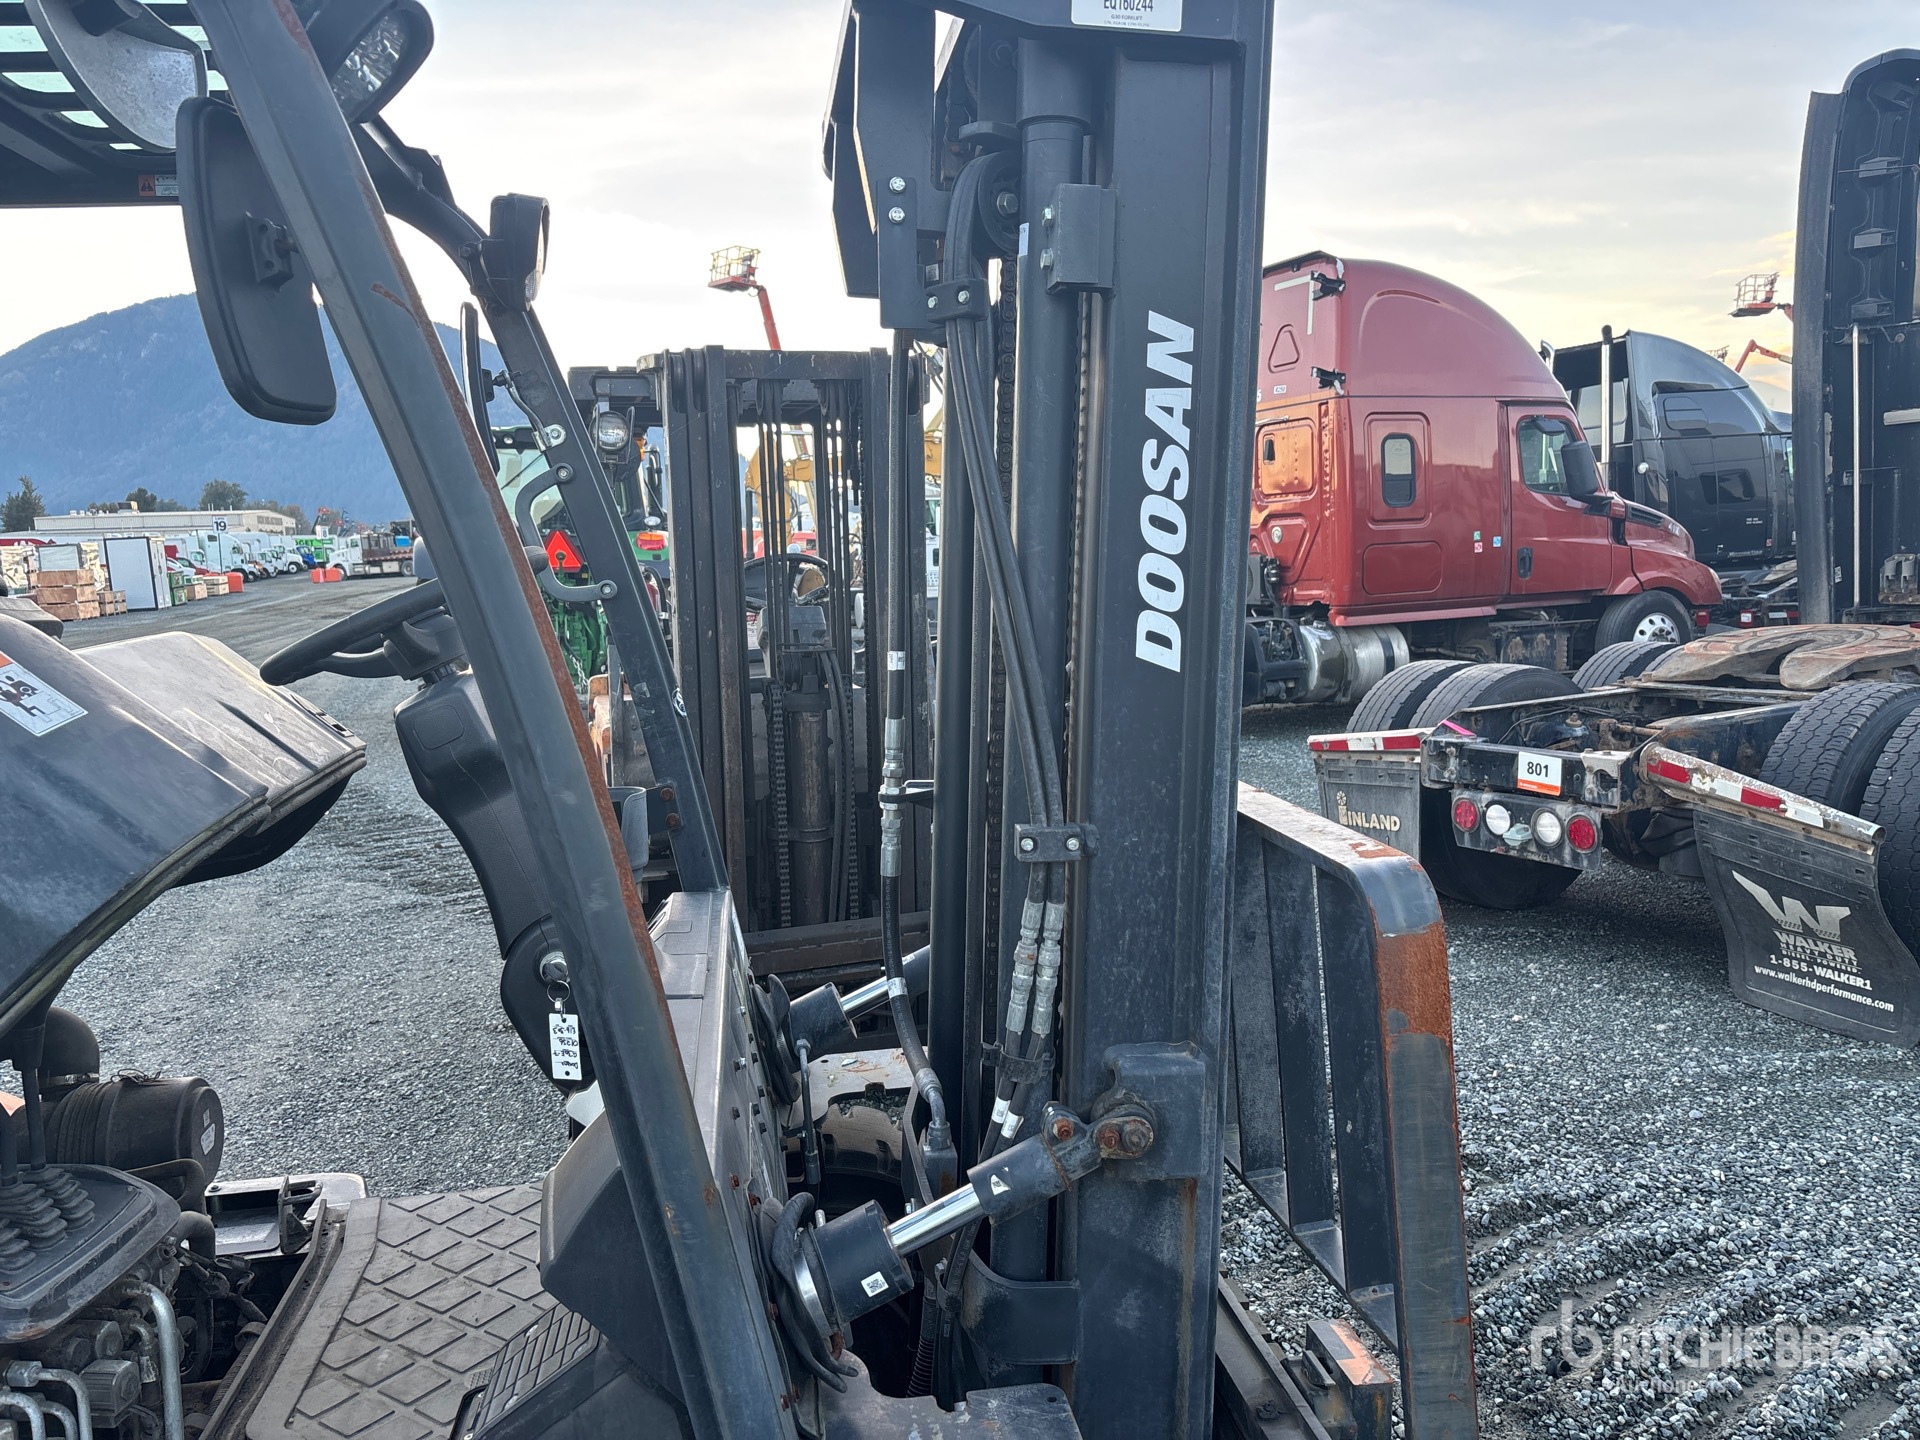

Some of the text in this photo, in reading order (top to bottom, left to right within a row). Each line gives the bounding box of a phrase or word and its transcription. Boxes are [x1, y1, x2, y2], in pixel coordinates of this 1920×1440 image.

[1135, 309, 1195, 673] DOOSAN
[213, 520, 227, 532] 19
[1526, 761, 1549, 778] 801
[1347, 811, 1401, 832] INLAND
[1774, 930, 1858, 961] WALKER
[1769, 954, 1873, 991] 1-855-WALKER1
[1826, 953, 1858, 967] DUTY
[1754, 964, 1895, 1013] www.walkerhdperformance.com
